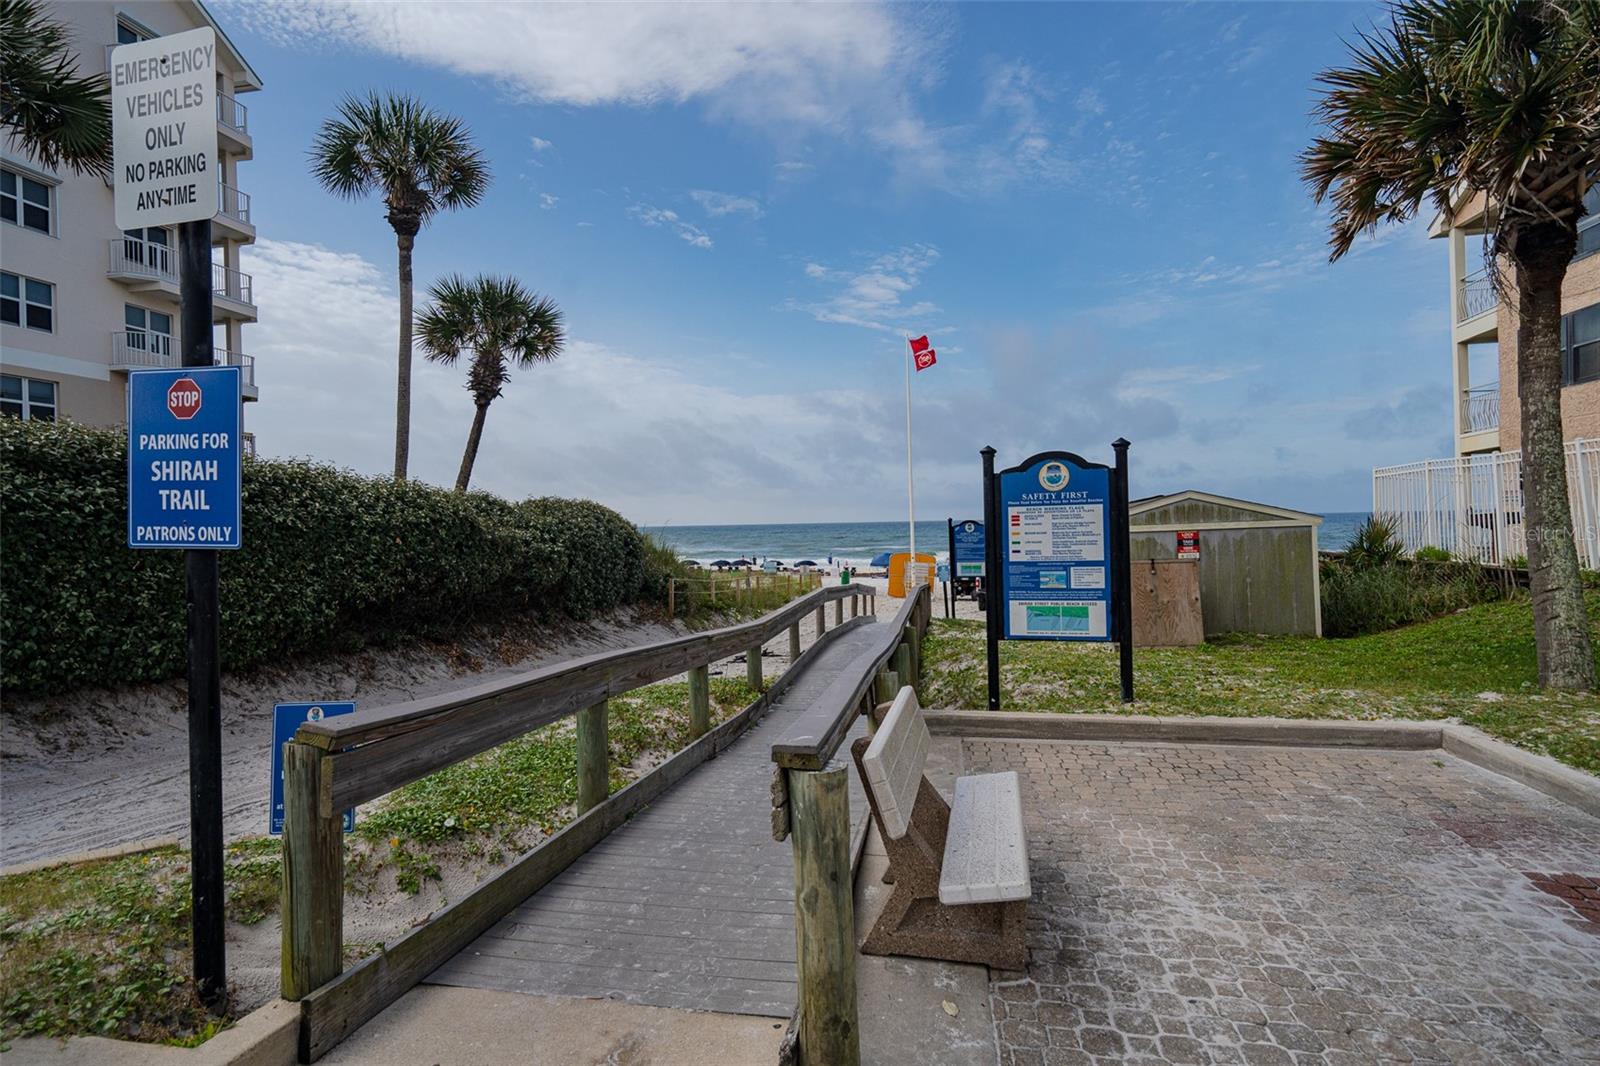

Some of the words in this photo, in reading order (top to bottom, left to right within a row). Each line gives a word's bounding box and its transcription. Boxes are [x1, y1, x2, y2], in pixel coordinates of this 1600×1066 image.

[114, 44, 213, 86] EMERGENCY
[126, 83, 203, 118] VEHICLES
[145, 122, 185, 150] ONLY
[126, 163, 145, 183] NO
[149, 153, 206, 180] PARKING
[170, 391, 199, 407] STOP
[140, 434, 199, 450] PARKING
[202, 433, 229, 449] FOR
[151, 460, 218, 481] SHIRAH
[159, 489, 210, 510] TRAIL
[1022, 492, 1057, 500] SAFETY
[1061, 491, 1088, 499] FIRST
[137, 526, 195, 541] PATRONS
[198, 526, 232, 541] ONLY
